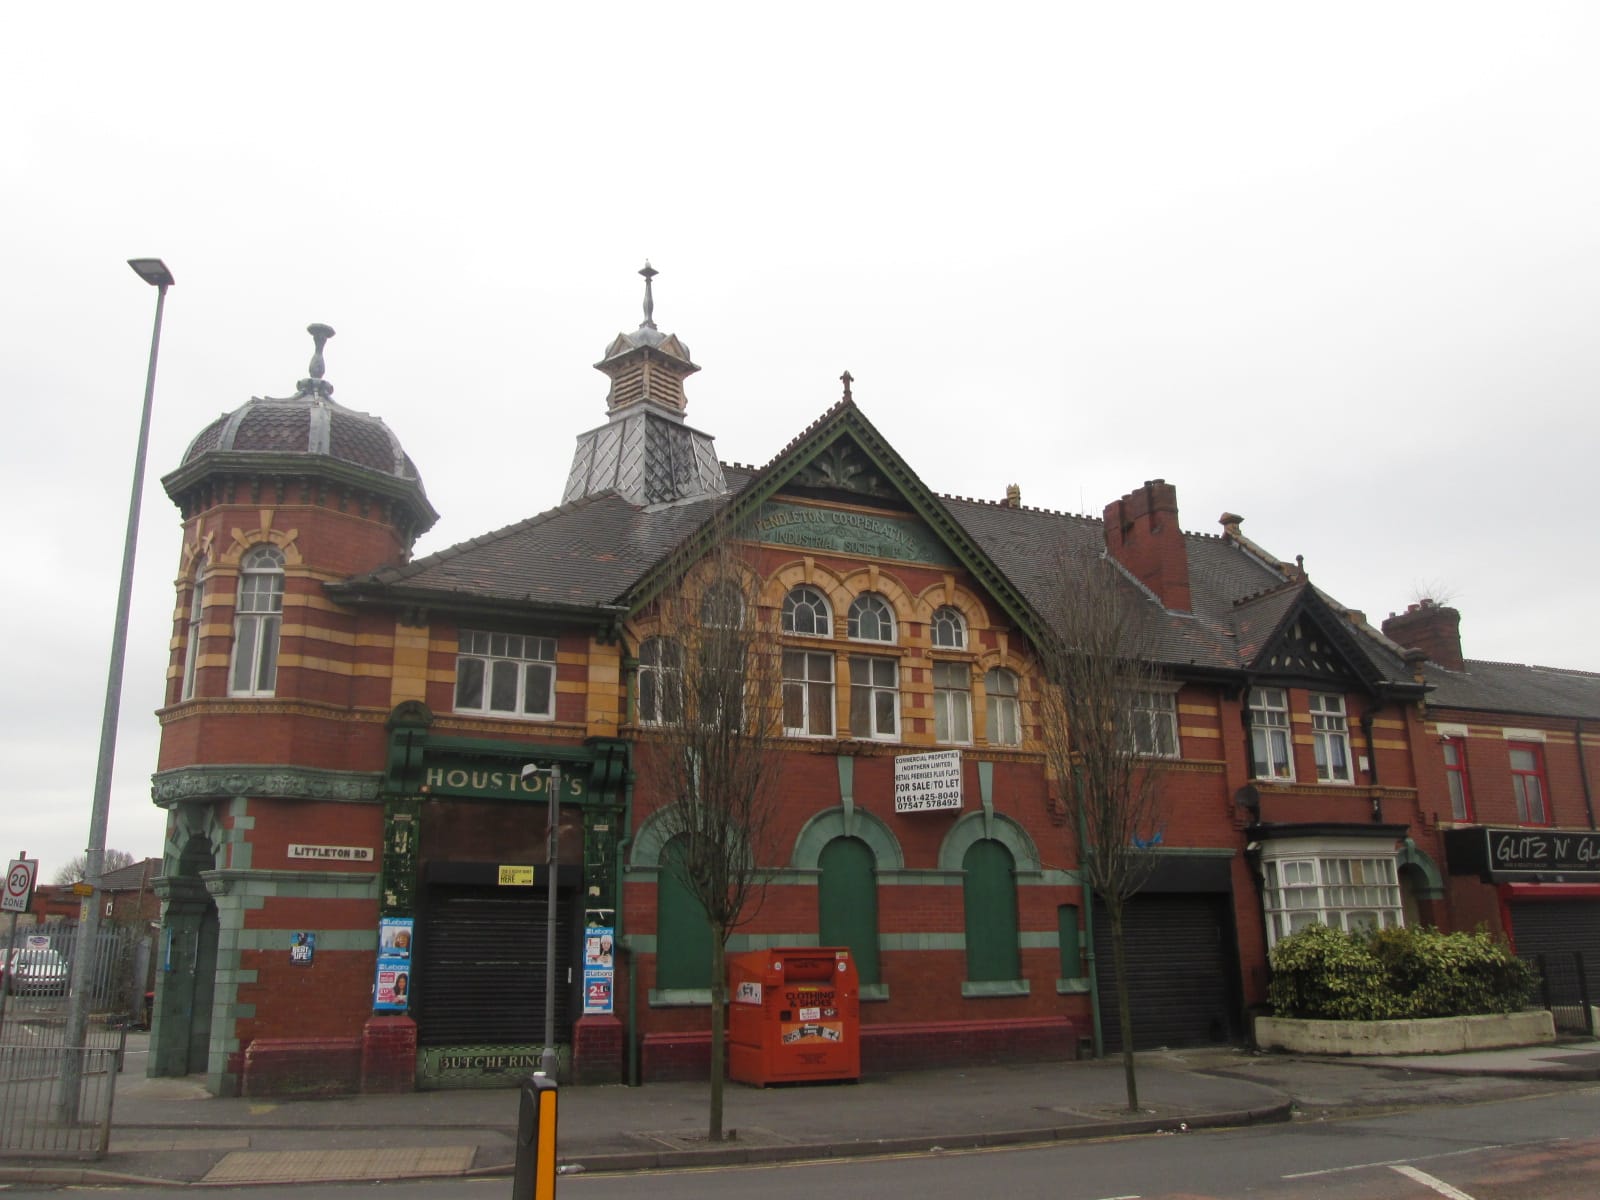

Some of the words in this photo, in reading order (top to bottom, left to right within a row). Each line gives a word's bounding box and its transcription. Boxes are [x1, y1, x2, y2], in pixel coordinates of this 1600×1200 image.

[755, 512, 825, 533] PENDLETON
[896, 756, 926, 764] COMMERCIAL
[896, 784, 910, 792] FOR
[946, 779, 959, 788] LET
[897, 792, 959, 803] 0161-425-8040
[898, 802, 923, 810] 07547
[927, 799, 958, 808] 578492
[294, 847, 351, 859] LITTLETON
[353, 849, 368, 859] RD
[1496, 835, 1548, 861] GLITZ
[1576, 837, 1600, 862] GL
[11, 874, 27, 888] 20
[3, 898, 25, 908] ZONE
[785, 991, 835, 1001] CLOTHING
[799, 999, 832, 1007] SHOES
